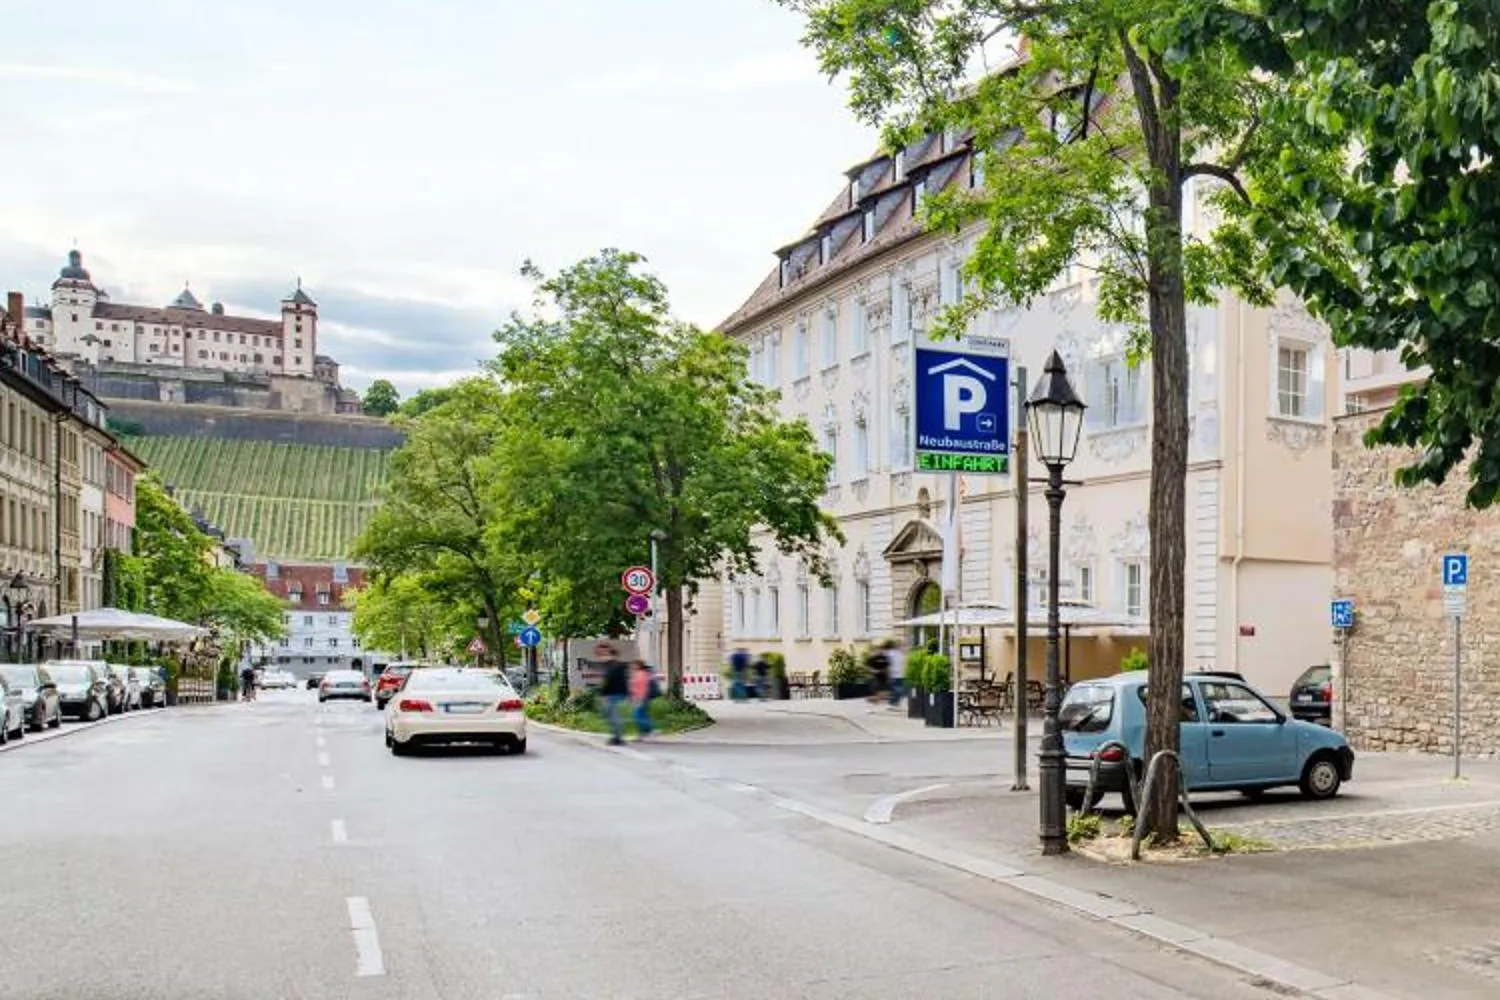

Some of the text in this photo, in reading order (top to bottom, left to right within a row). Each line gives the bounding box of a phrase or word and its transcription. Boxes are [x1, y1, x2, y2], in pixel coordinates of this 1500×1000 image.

[944, 374, 987, 430] P
[919, 435, 1006, 450] Neubaustraße
[920, 454, 1003, 471] EINFAHRT
[1448, 559, 1461, 583] P
[630, 573, 648, 587] 30
